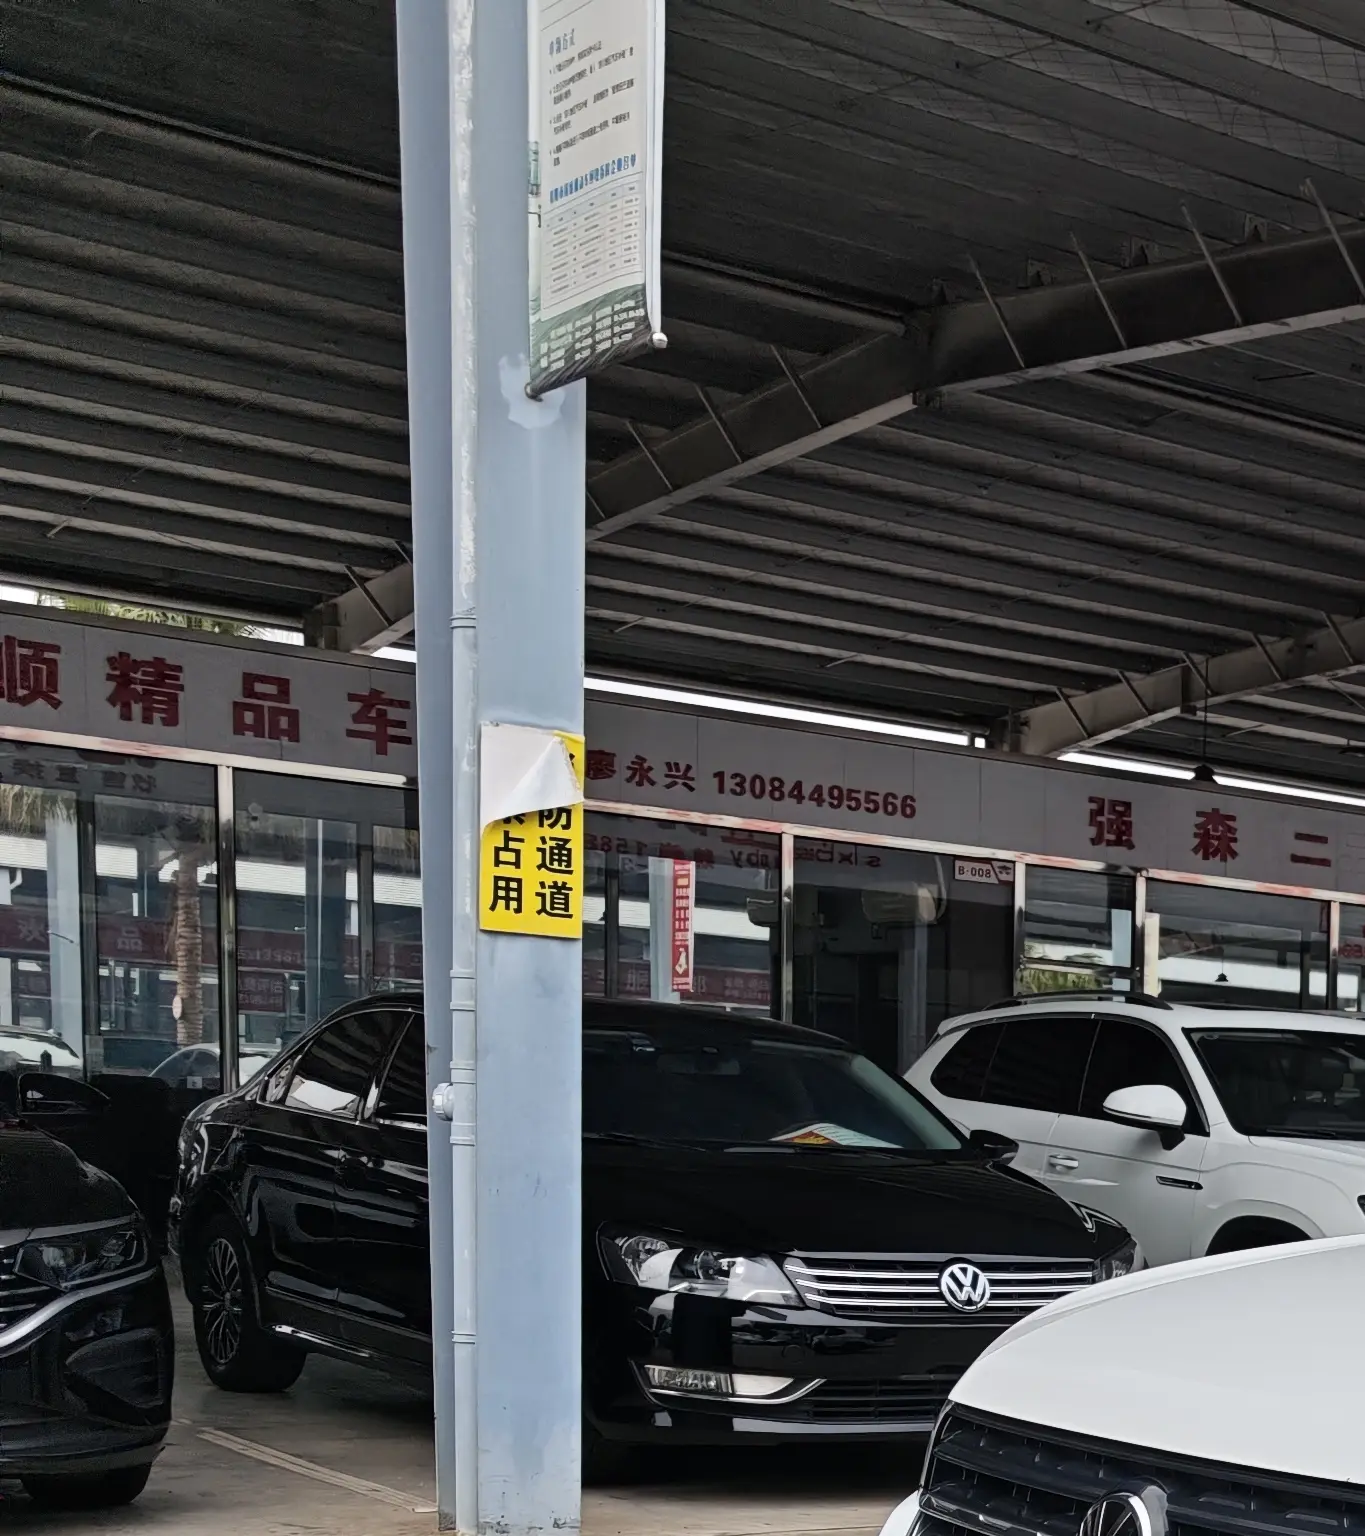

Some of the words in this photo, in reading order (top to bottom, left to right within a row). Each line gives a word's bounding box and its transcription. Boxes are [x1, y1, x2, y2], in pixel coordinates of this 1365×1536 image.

[585, 750, 696, 792] 廖永兴
[712, 770, 917, 819] 13084495566
